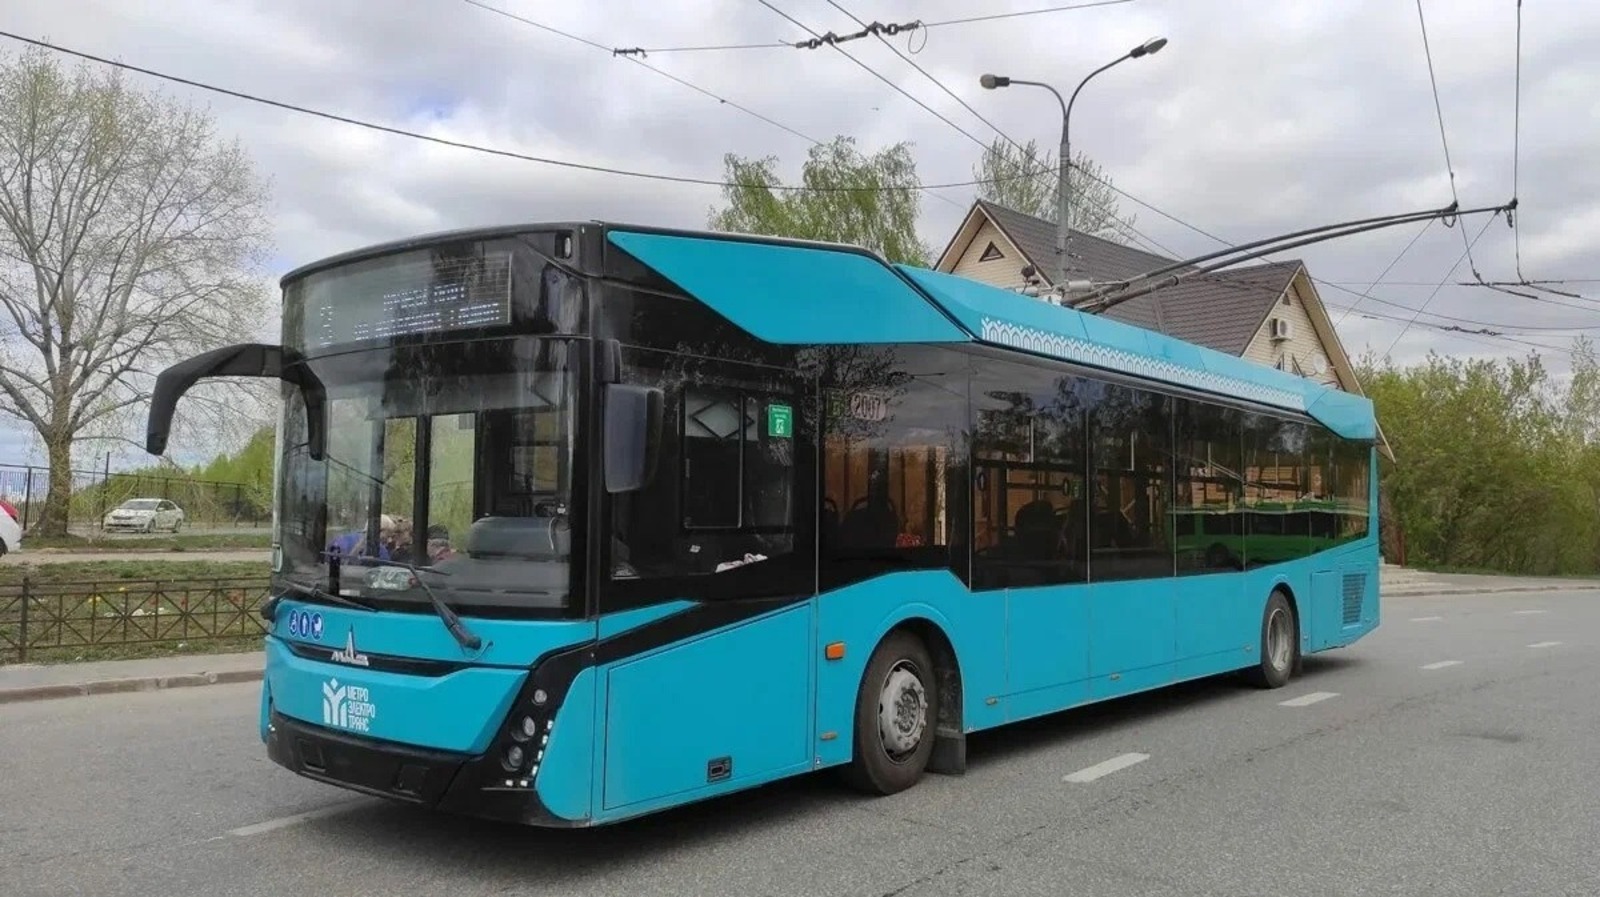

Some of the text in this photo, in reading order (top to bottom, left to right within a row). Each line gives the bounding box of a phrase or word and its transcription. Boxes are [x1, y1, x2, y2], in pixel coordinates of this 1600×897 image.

[347, 685, 369, 702] МЕТРО
[347, 700, 376, 718] ЭЛЕКТРО
[348, 715, 370, 732] ТРАНС
